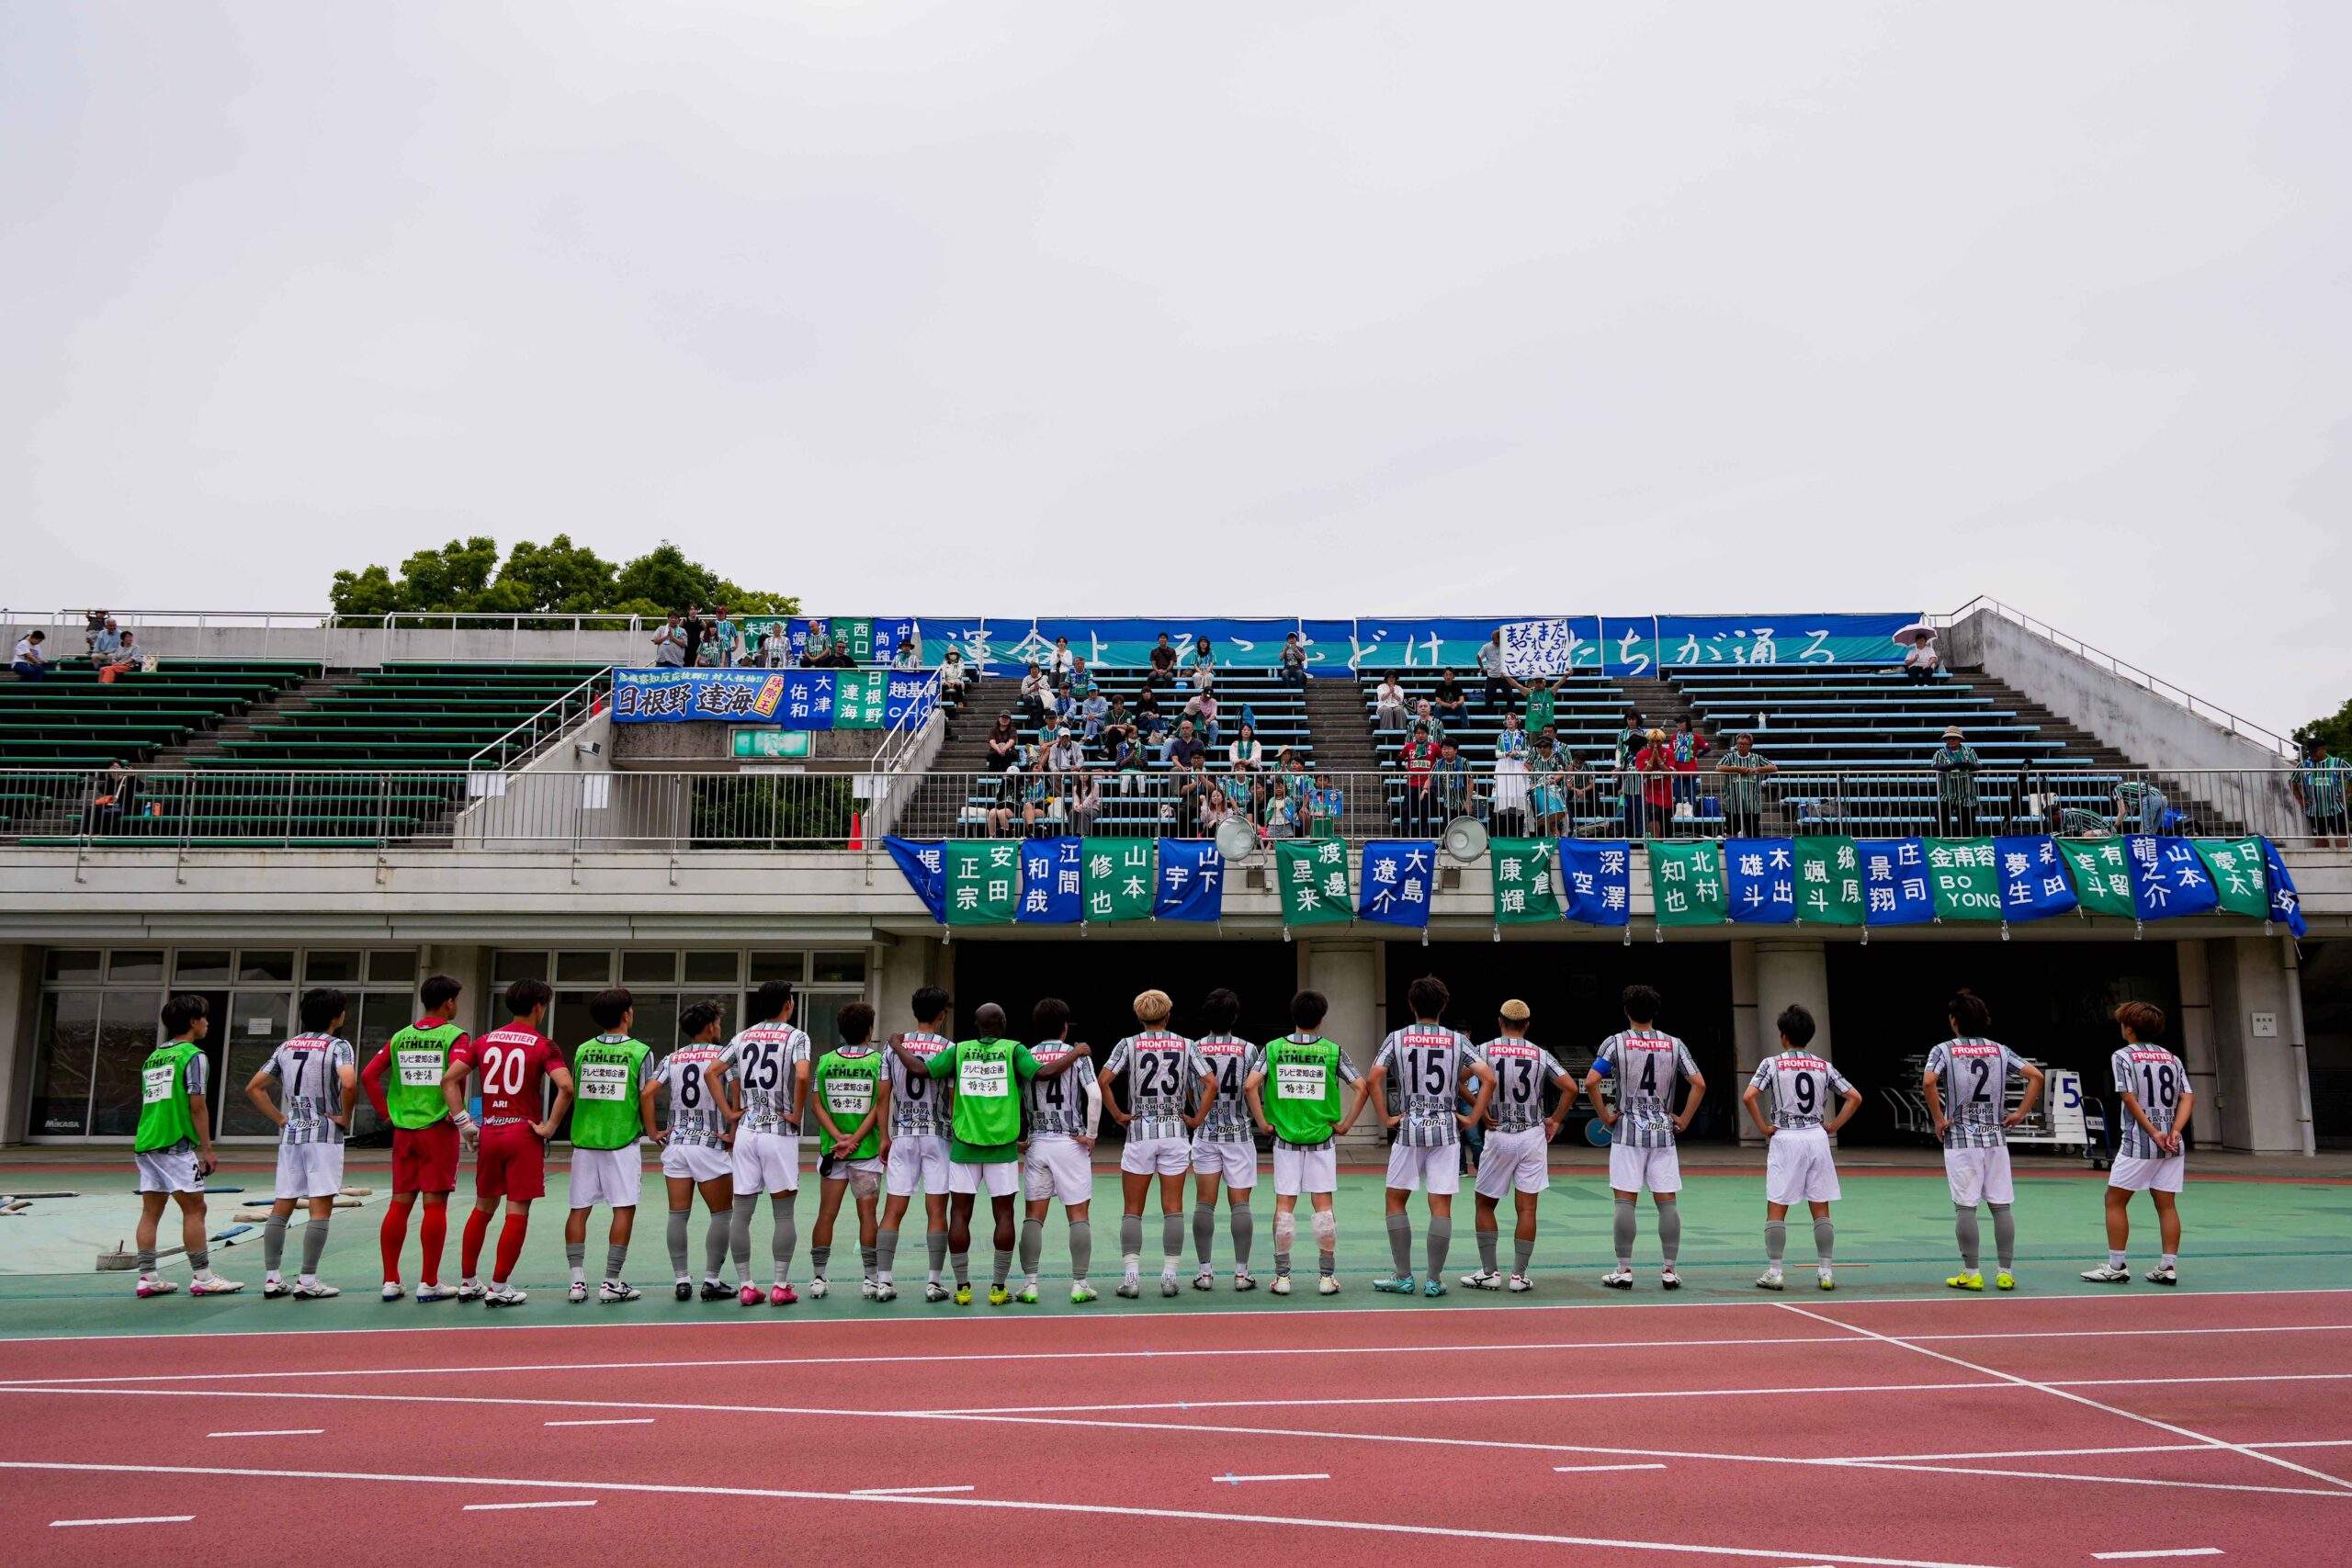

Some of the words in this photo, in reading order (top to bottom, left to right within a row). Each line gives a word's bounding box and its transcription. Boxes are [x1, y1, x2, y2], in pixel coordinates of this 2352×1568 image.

[854, 623, 869, 654] 西口
[897, 623, 910, 654] 中
[1506, 620, 1566, 642] まだまだ
[1505, 649, 1568, 664] こんなもん
[616, 682, 692, 716] 日根野
[695, 682, 754, 716] 達海
[790, 683, 809, 718] 佑和
[813, 675, 831, 713] 大津
[840, 683, 859, 720] 達海
[865, 671, 884, 724] 日根野
[956, 857, 980, 910] 正宗
[989, 845, 1013, 901] 安田
[1026, 857, 1049, 913] 和哉
[1058, 843, 1080, 895] 江間
[1089, 854, 1114, 914] 修也
[1123, 845, 1147, 899] 山本
[1164, 866, 1189, 904] 宇一
[1198, 847, 1219, 893] 山下
[1292, 859, 1321, 912] 星来
[1373, 857, 1397, 914] 遼介
[1401, 848, 1428, 904] 大島
[1498, 857, 1526, 914] 康輝
[1531, 840, 1553, 896] 大倉
[1572, 871, 1596, 895] 空
[1600, 851, 1625, 911] 深澤
[1661, 859, 1689, 913] 知也
[1690, 851, 1719, 903] 北村
[1740, 854, 1764, 908] 雄斗
[1769, 848, 1793, 904] 木出
[1804, 859, 1830, 912] 颯斗
[1868, 855, 1896, 912] 景翔
[1897, 843, 1927, 901] 庄司
[1940, 875, 1972, 889] BO
[2005, 852, 2032, 905] 夢生
[2098, 845, 2130, 897] 有留
[2132, 838, 2171, 908] 龍之介
[2165, 845, 2206, 888] 山本
[1947, 893, 2001, 908] YONG
[287, 1040, 328, 1049] FRONTIER
[399, 1041, 443, 1049] ATHLETA
[489, 1032, 537, 1045] FRONTIER
[672, 1051, 718, 1063] FRONTIER
[743, 1031, 788, 1041] FRONTIER
[902, 1042, 944, 1053] RONTIER
[1031, 1053, 1068, 1062] RONTIE
[1136, 1039, 1182, 1049] FRONTIER
[1403, 1036, 1452, 1046] FRONTIER
[1489, 1046, 1537, 1057] FRONTIER
[1626, 1039, 1671, 1049] FRONTIER
[1951, 1045, 1998, 1055] FRONTIER
[292, 1052, 310, 1096] 7
[483, 1046, 526, 1095] 20
[582, 1054, 629, 1064] ATHLETA
[742, 1043, 779, 1090] 25
[826, 1067, 873, 1077] ATHLETA
[1140, 1052, 1180, 1097] 23
[1277, 1055, 1325, 1064] ATHLETA
[1408, 1048, 1445, 1096] 15
[1496, 1057, 1532, 1104] 13
[1640, 1054, 1657, 1097] 4
[1778, 1059, 1825, 1070] FRONTIER
[1970, 1059, 1991, 1102] 2
[492, 1100, 508, 1109] ARI
[681, 1064, 700, 1109] 8
[1410, 1100, 1444, 1110] OSHIMA
[1795, 1072, 1815, 1115] 9
[2063, 1078, 2080, 1108] 5
[2143, 1065, 2175, 1108] 18
[900, 1108, 930, 1116] SHUYA
[1968, 1108, 1994, 1116] KURA
